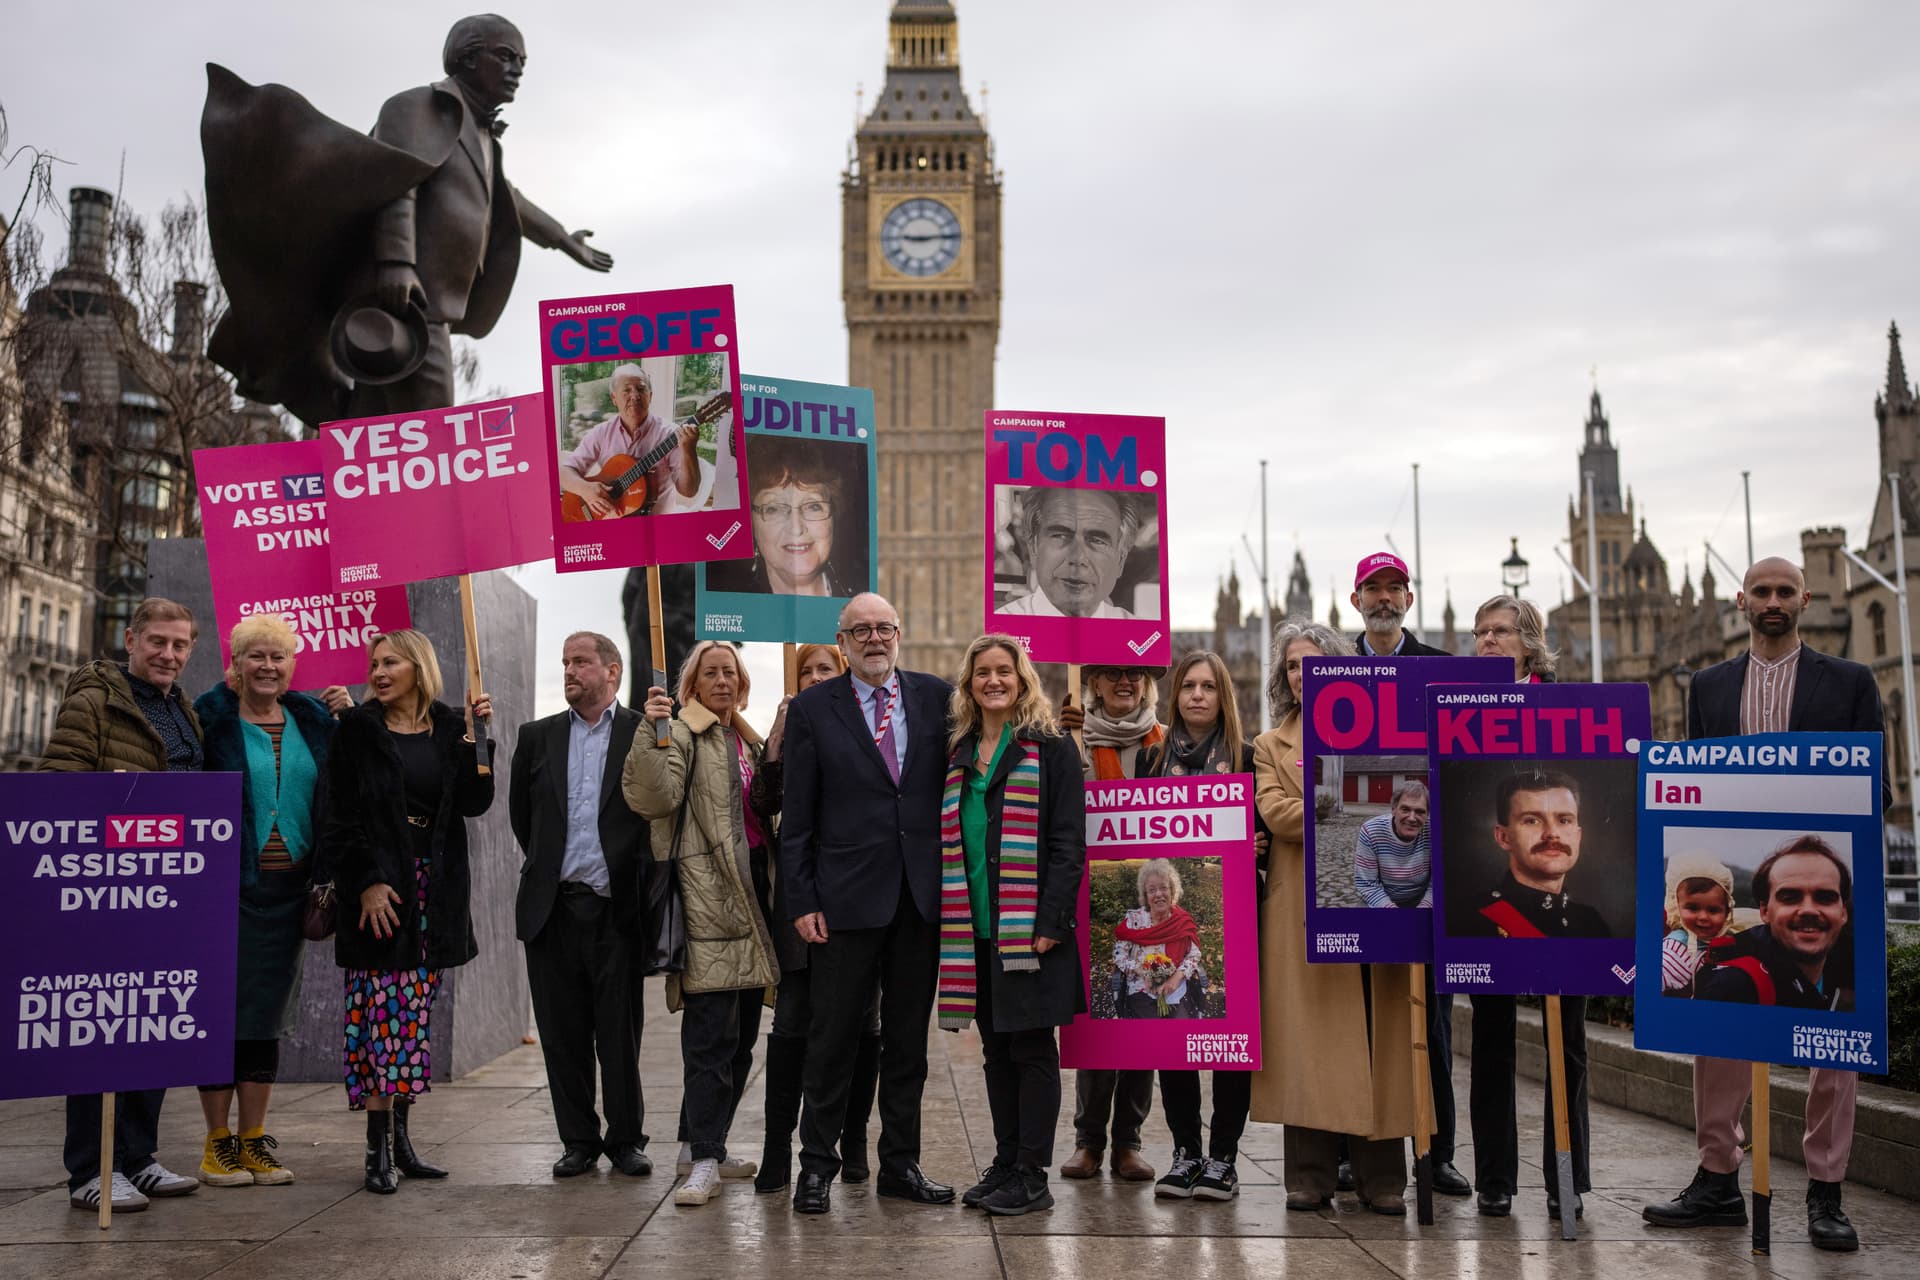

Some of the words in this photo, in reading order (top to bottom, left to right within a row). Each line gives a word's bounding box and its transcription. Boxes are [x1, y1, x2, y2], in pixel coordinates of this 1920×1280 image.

[548, 304, 602, 316] CAMPAIGN
[605, 303, 626, 312] FOR
[551, 308, 728, 359] GEOFF.
[758, 385, 778, 394] FOR
[740, 395, 868, 438] UDITH.
[993, 418, 1044, 427] CAMPAIGN
[1046, 420, 1066, 428] FOR
[329, 419, 429, 460] YES
[994, 430, 1159, 487] TOM.
[333, 442, 530, 499] CHOICE.
[204, 480, 278, 504] VOTE
[285, 476, 326, 497] YE
[233, 501, 327, 528] ASSIST
[564, 547, 602, 557] DIGNITY
[565, 556, 573, 564] IN
[575, 554, 606, 562] DYING.
[240, 594, 335, 615] CAMPAIGN
[341, 590, 376, 604] FOR
[241, 603, 377, 632] GNITY
[705, 618, 742, 626] DIGNITY
[716, 624, 745, 633] DYING.
[1312, 667, 1371, 676] CAMPAIGN
[1374, 667, 1397, 676] FOR
[1437, 695, 1498, 704] CAMPAIGN
[1501, 695, 1525, 703] FOR
[1313, 681, 1427, 750] OL
[1437, 708, 1640, 754] KEITH.
[1648, 746, 1797, 766] CAMPAIGN
[1810, 746, 1871, 767] FOR
[1085, 785, 1188, 808] AMPAIGN
[1197, 783, 1244, 803] FOR
[1655, 780, 1702, 804] Ian
[5, 820, 98, 844] VOTE
[111, 819, 178, 843] YES
[191, 818, 233, 842] TO
[1097, 814, 1213, 841] ALISON
[33, 852, 205, 878] ASSISTED
[60, 885, 178, 911] DYING.
[1317, 938, 1359, 946] DIGNITY
[1317, 945, 1327, 953] IN
[1328, 945, 1363, 953] DYING.
[21, 971, 144, 992] CAMPAIGN
[153, 969, 198, 986] FOR
[1446, 968, 1491, 976] DIGNITY
[1446, 976, 1457, 984] IN
[1458, 975, 1494, 984] DYING.
[19, 986, 198, 1022] DIGNITY
[18, 1021, 60, 1050] IN
[69, 1014, 207, 1047] DYING.
[1793, 1025, 1848, 1037] CAMPAIGN
[1851, 1031, 1873, 1040] FOR
[1793, 1033, 1873, 1052] DIGNITY
[1186, 1040, 1249, 1052] DIGNITY
[1187, 1051, 1201, 1063] IN
[1203, 1051, 1254, 1063] DYING.
[1793, 1046, 1811, 1059] IN
[1814, 1047, 1878, 1066] DYING.
